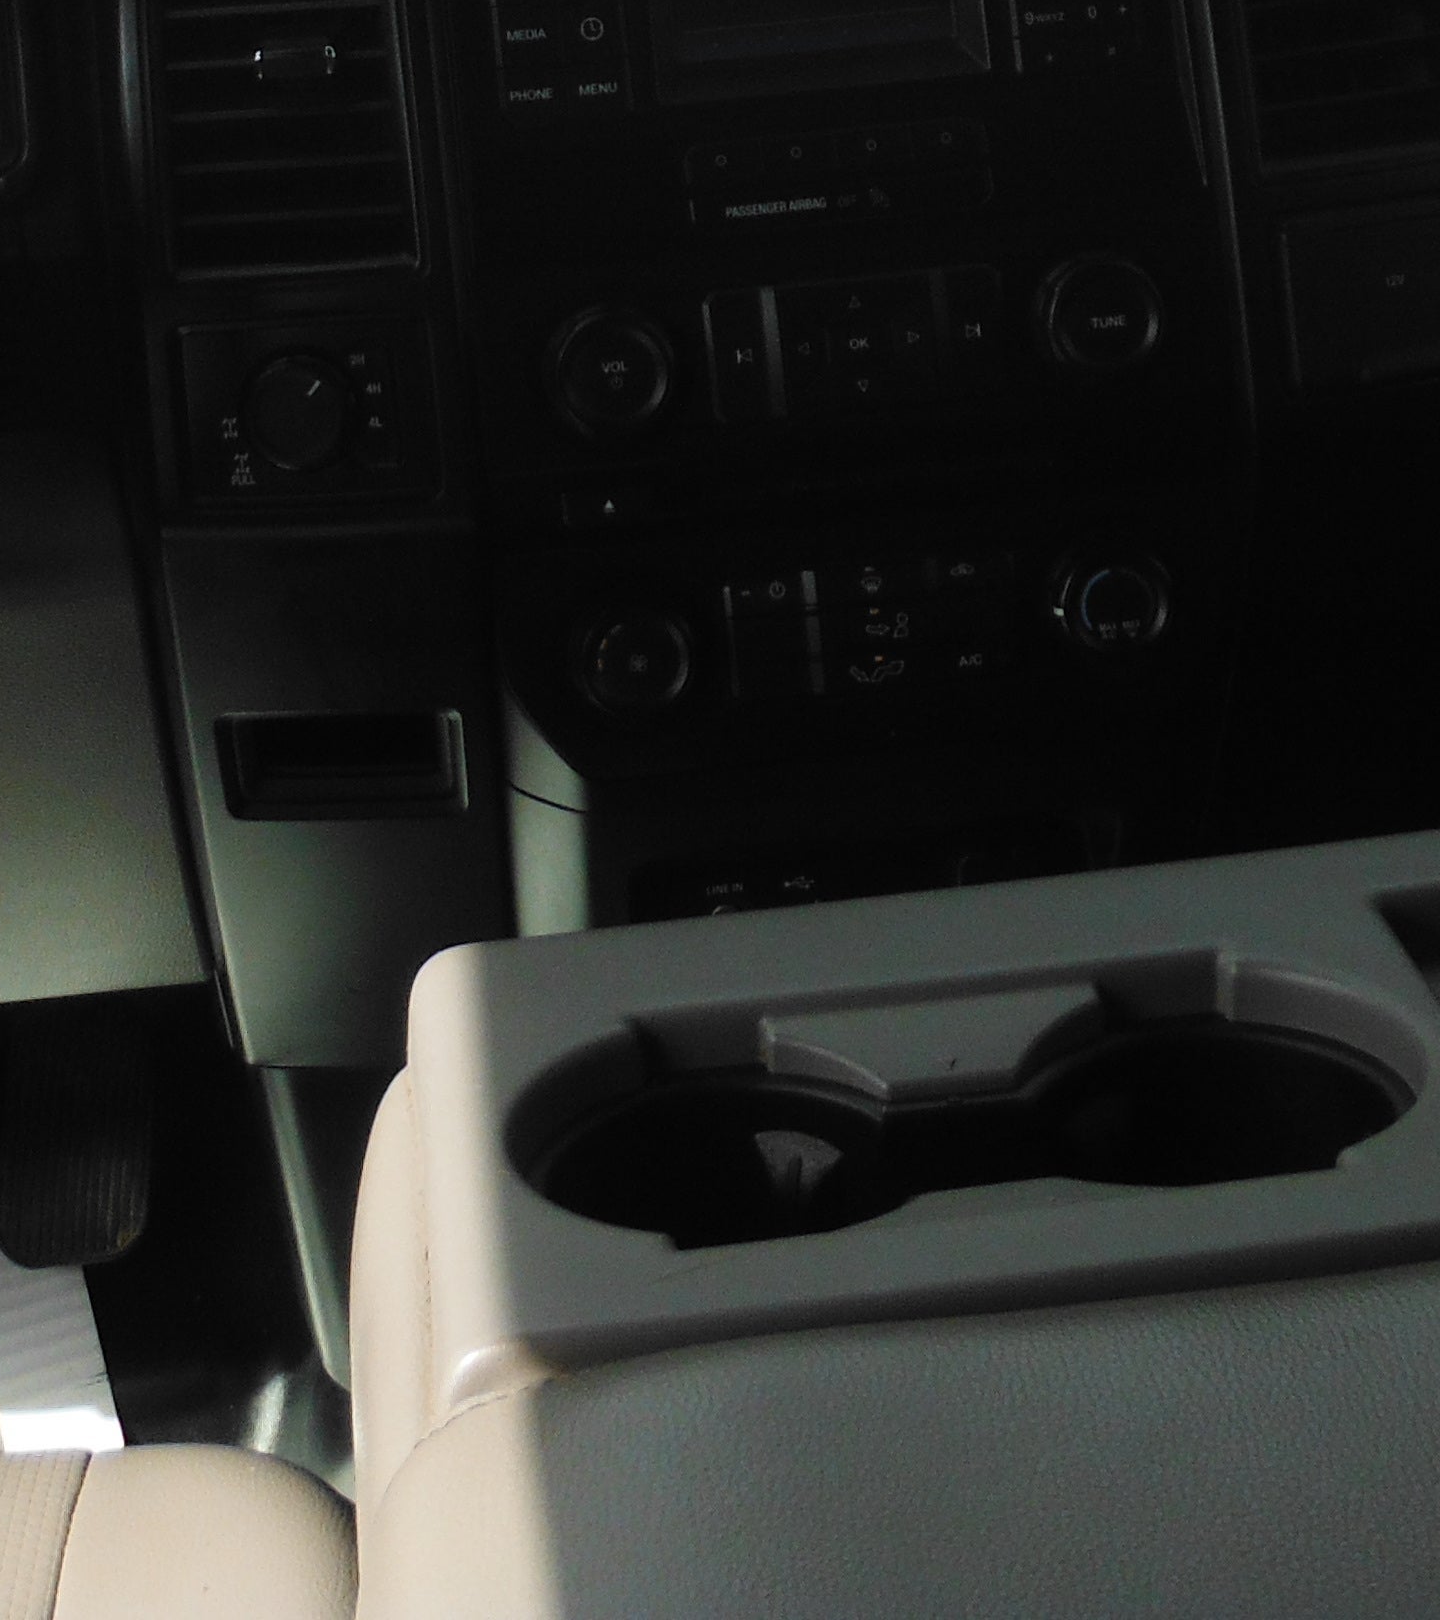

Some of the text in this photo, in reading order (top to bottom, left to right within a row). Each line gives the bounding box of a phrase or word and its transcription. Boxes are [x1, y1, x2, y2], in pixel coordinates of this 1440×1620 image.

[1024, 12, 1034, 25] 9
[506, 29, 547, 41] MEDIA
[510, 89, 553, 102] PHONE
[578, 83, 618, 97] MENU
[725, 201, 787, 218] PASSENGER
[788, 197, 827, 212] AIRBAG
[1090, 315, 1127, 330] TUNE
[848, 338, 870, 350] OK
[601, 361, 628, 373] VOL
[959, 654, 983, 667] A/C
